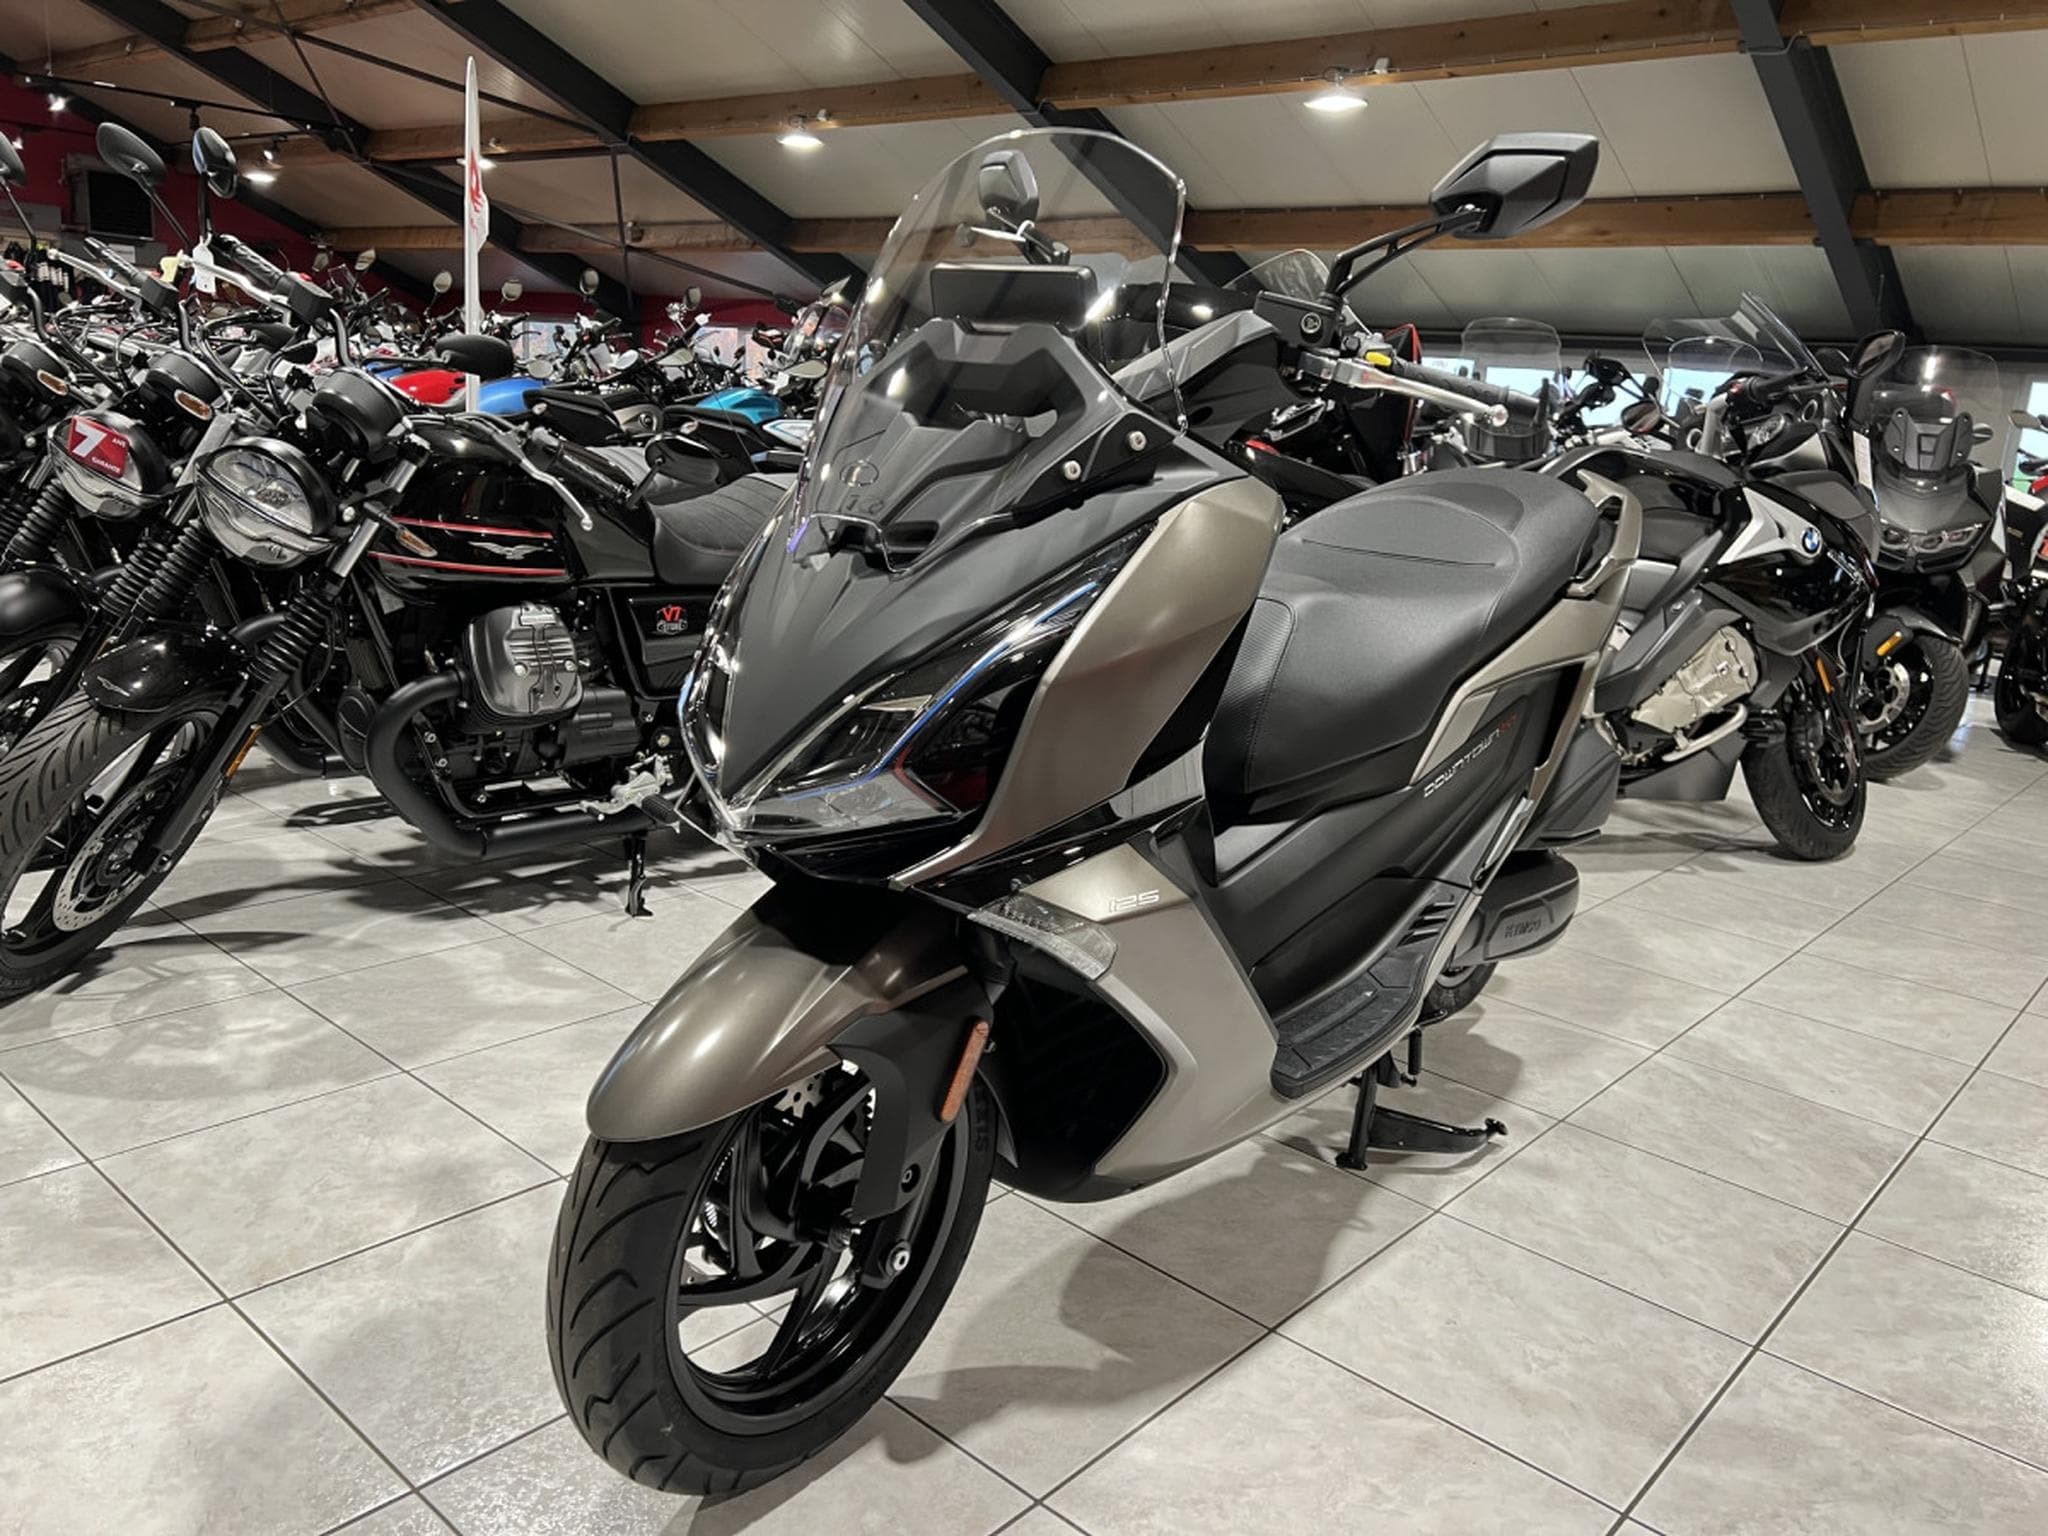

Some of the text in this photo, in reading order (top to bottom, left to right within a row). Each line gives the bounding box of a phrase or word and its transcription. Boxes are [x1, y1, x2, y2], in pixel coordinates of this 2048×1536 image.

[72, 419, 107, 458] 7
[661, 605, 682, 622] V7
[1109, 889, 1160, 912] 125
